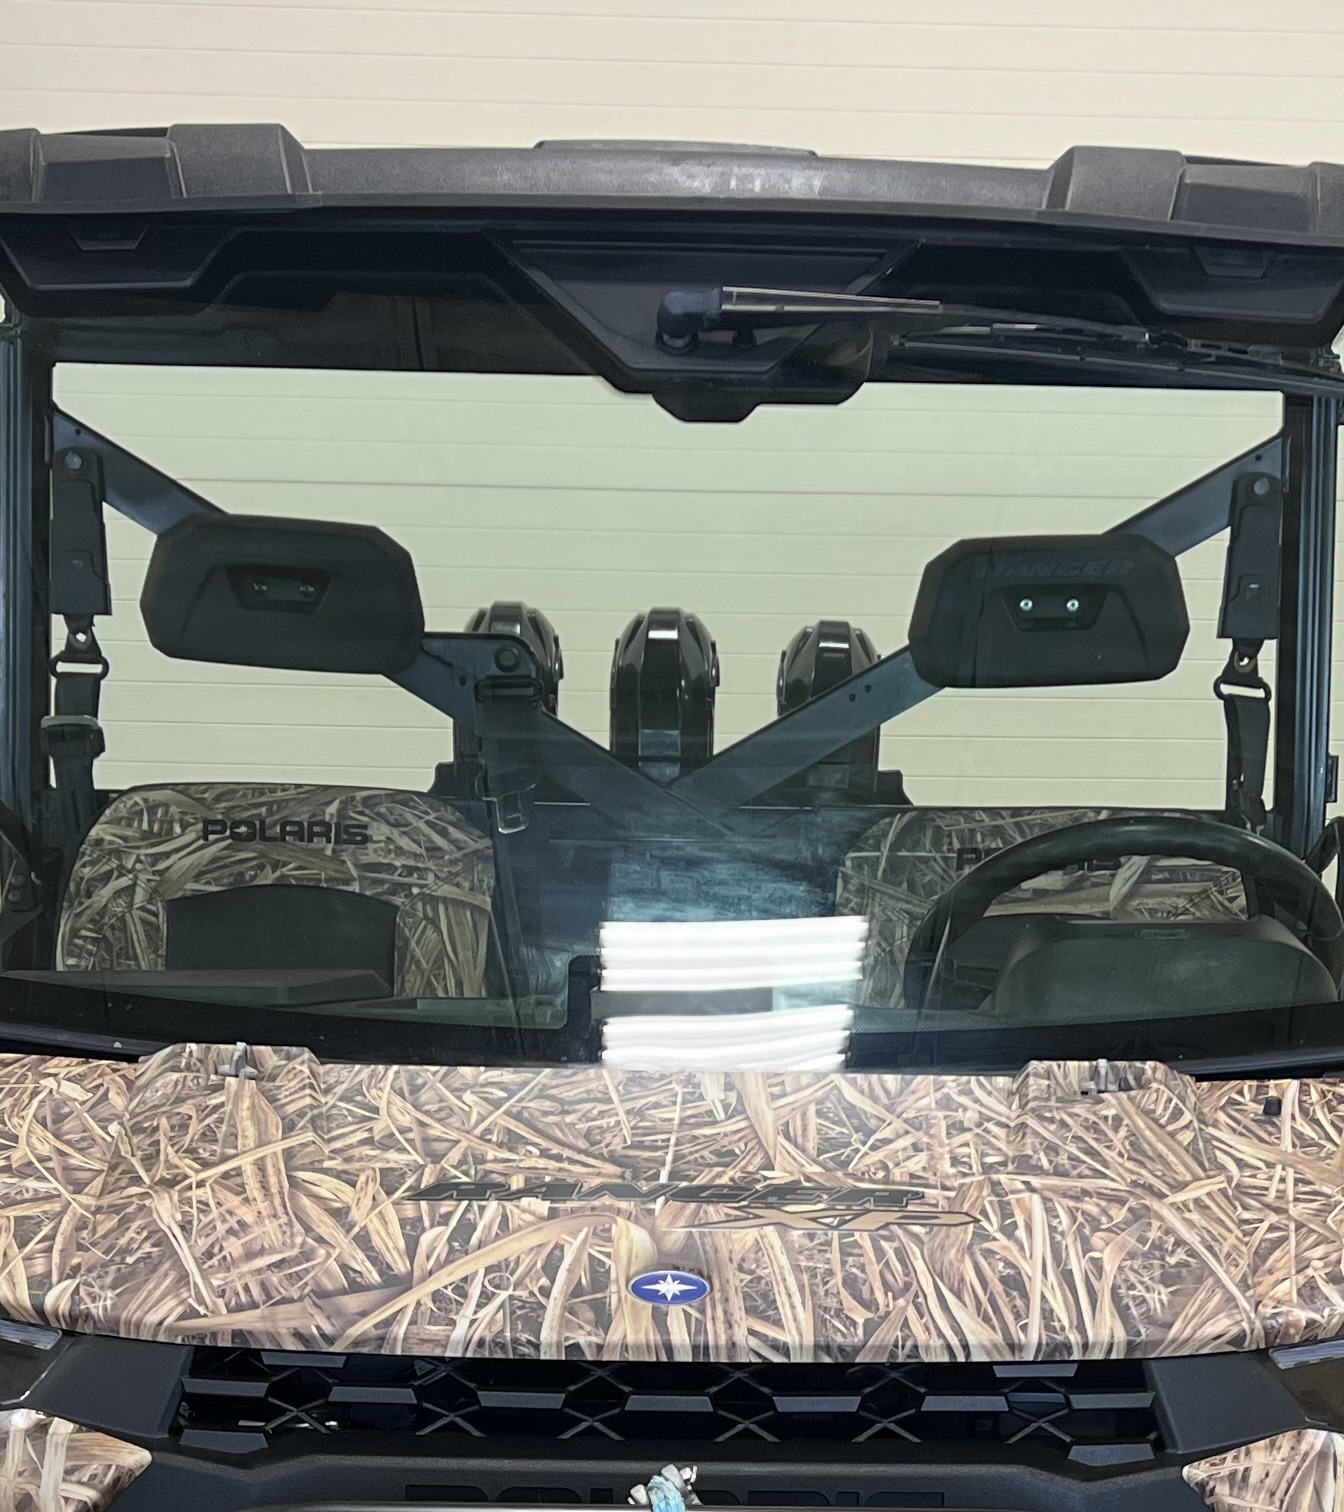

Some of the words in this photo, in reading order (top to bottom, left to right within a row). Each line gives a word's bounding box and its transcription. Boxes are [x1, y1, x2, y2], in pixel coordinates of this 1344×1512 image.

[202, 819, 369, 846] POLARIS
[408, 1181, 924, 1207] RANGER
[661, 1206, 981, 1230] XP
